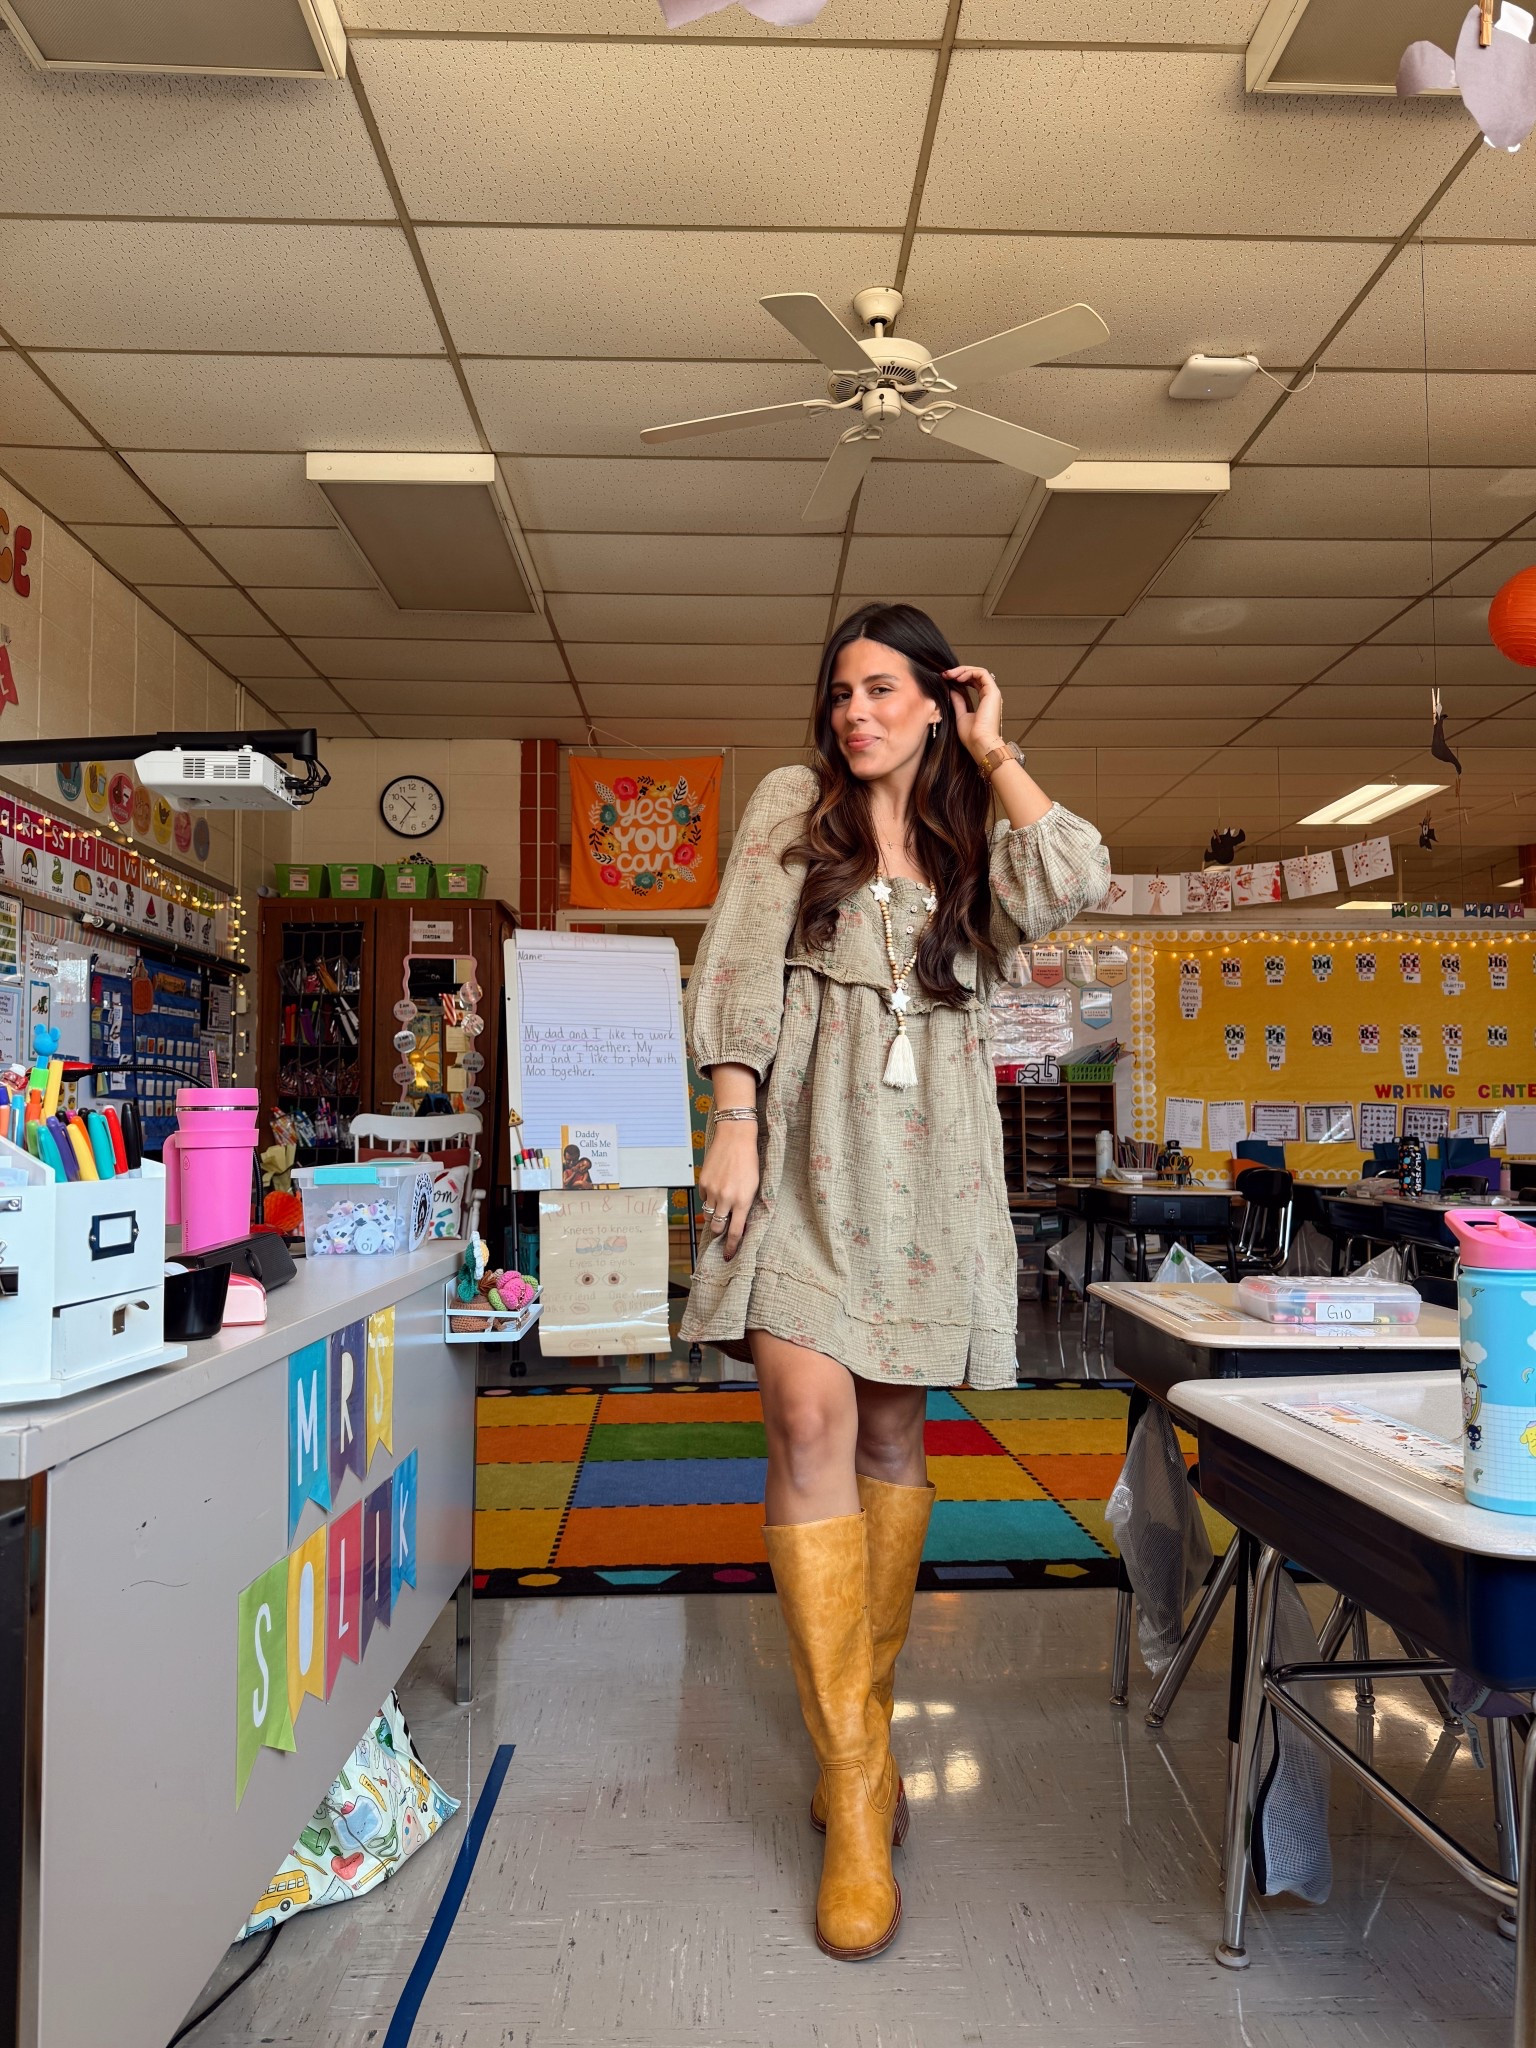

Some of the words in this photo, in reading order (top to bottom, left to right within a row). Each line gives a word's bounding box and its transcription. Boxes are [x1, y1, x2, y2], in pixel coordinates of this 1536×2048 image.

[392, 793, 400, 801] 10
[615, 797, 673, 825] yes
[20, 812, 40, 840] Rr
[51, 825, 65, 850] Ss
[614, 825, 677, 851] YOU
[79, 836, 91, 861] Tt
[101, 846, 115, 871] Uu
[616, 851, 678, 873] can
[123, 856, 138, 879] Vv
[1392, 904, 1449, 913] WORD
[1465, 904, 1521, 914] WALL
[518, 951, 543, 961] Name
[1358, 958, 1375, 968] Ee
[1402, 957, 1419, 968] Ff
[1488, 957, 1507, 968] Hh
[1181, 963, 1199, 974] Aa
[1222, 962, 1240, 973] Bb
[1266, 960, 1284, 971] Cc
[1313, 959, 1331, 970] Dd
[1442, 958, 1460, 973] Gg
[524, 1025, 540, 1039] My
[545, 1026, 565, 1039] dad
[569, 1028, 588, 1039] and
[592, 1027, 601, 1040] I
[609, 1027, 625, 1040] like
[632, 1028, 644, 1040] to
[650, 1029, 675, 1040] work
[1226, 1029, 1244, 1039] Oo
[1267, 1029, 1284, 1044] Pp
[1313, 1030, 1332, 1044] Qq
[1360, 1028, 1378, 1039] Rr
[1403, 1028, 1418, 1039] Ss
[1446, 1028, 1459, 1039] Tt
[524, 1043, 538, 1051] on
[541, 1043, 556, 1053] my
[562, 1043, 577, 1051] car
[637, 1041, 653, 1055] My
[524, 1053, 544, 1064] dad
[551, 1053, 571, 1064] and
[577, 1053, 584, 1063] I
[591, 1052, 608, 1064] like
[613, 1054, 624, 1064] to
[630, 1052, 651, 1067] play
[656, 1053, 677, 1064] with
[525, 1064, 546, 1077] Moo
[552, 1065, 595, 1080] together.
[1374, 1084, 1456, 1100] WRITING
[575, 1130, 600, 1140] Daddy
[579, 1139, 598, 1148] Calls
[599, 1139, 612, 1148] Me
[591, 1149, 608, 1158] Man
[1415, 1152, 1423, 1192] ALYSSA
[601, 1196, 612, 1213] &
[624, 1195, 661, 1217] Talk
[563, 1226, 594, 1236] Knees
[597, 1224, 607, 1233] to
[610, 1225, 642, 1234] knees.
[569, 1260, 592, 1268] Eyes
[596, 1258, 606, 1267] to
[609, 1259, 636, 1268] eyes.
[1327, 1304, 1352, 1320] Gio
[297, 1331, 387, 1487] MRS
[252, 1481, 410, 1728] SOLIK
